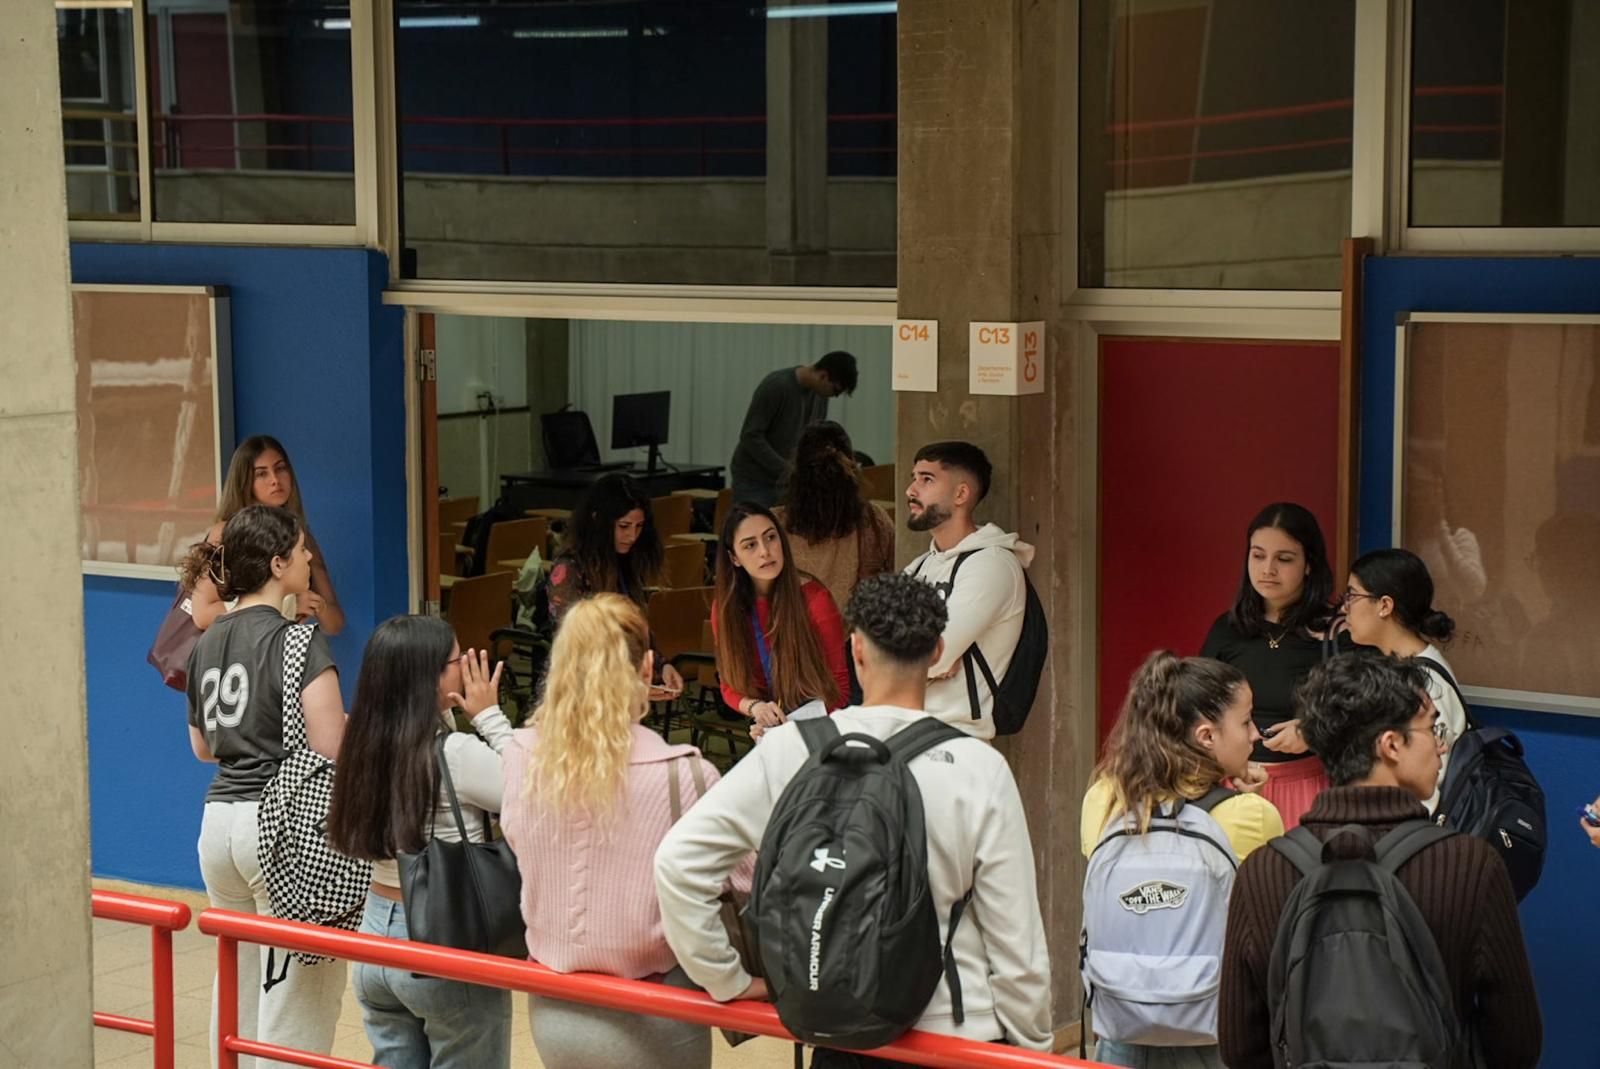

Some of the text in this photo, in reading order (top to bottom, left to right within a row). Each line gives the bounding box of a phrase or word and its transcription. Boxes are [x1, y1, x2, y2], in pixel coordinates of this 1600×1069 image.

[899, 324, 929, 341] C14
[979, 327, 1010, 344] C13
[1024, 331, 1037, 382] C13
[200, 662, 249, 731] 29
[1144, 892, 1161, 904] THE
[809, 887, 835, 991] UNDER ARMOUR
